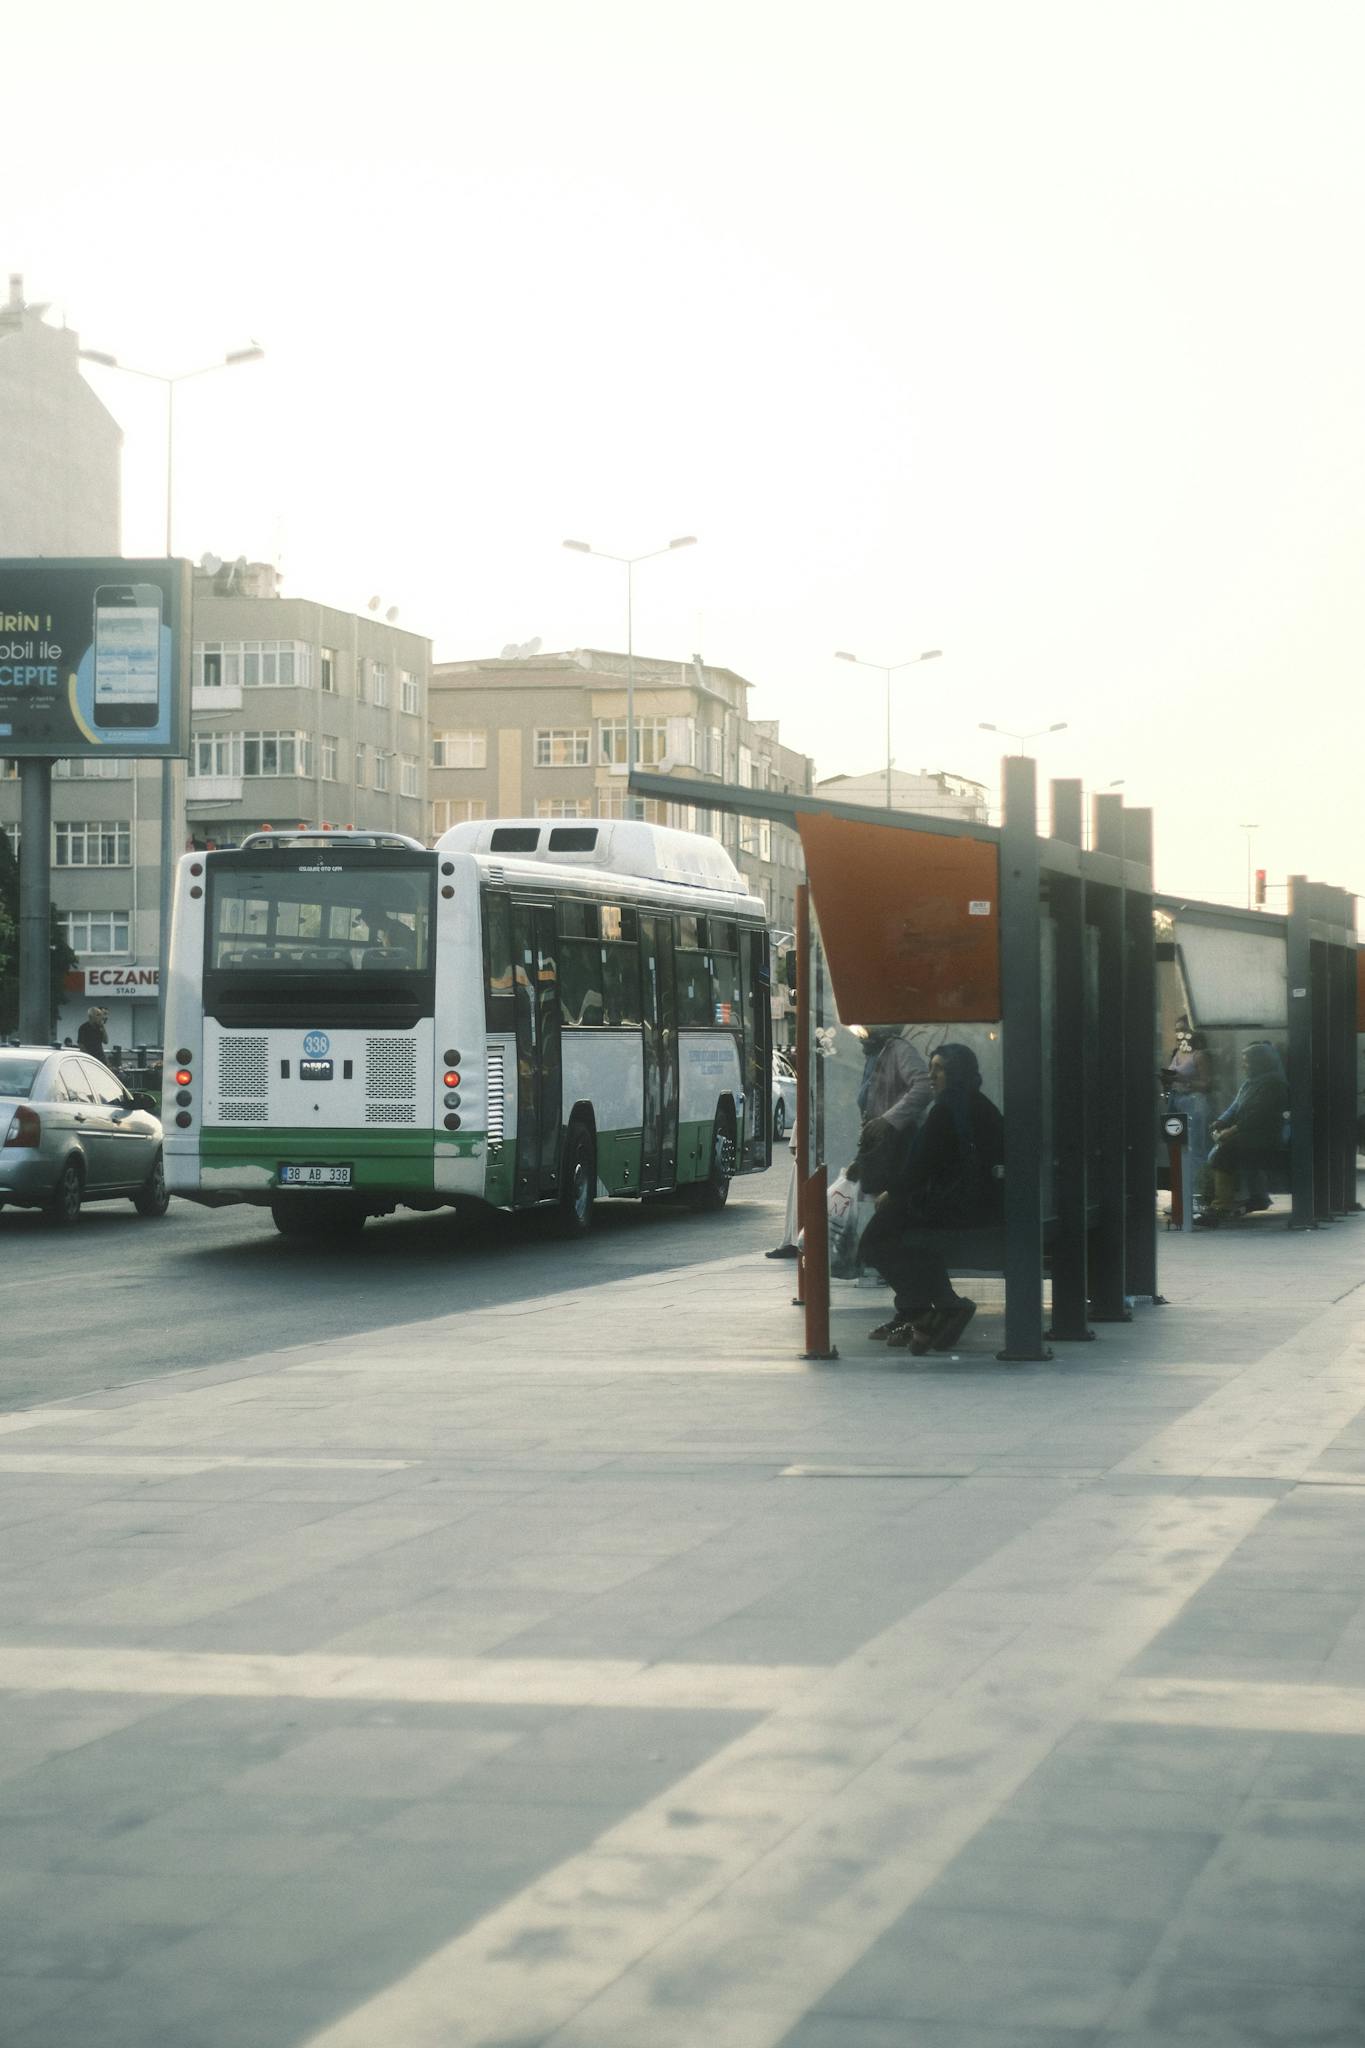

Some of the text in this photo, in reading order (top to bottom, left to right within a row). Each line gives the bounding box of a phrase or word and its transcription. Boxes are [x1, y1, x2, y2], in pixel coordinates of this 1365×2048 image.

[0, 641, 62, 659] obil ile
[0, 666, 57, 686] CEPTE
[305, 1037, 327, 1053] 338
[288, 1168, 348, 1180] 38 AB 338
